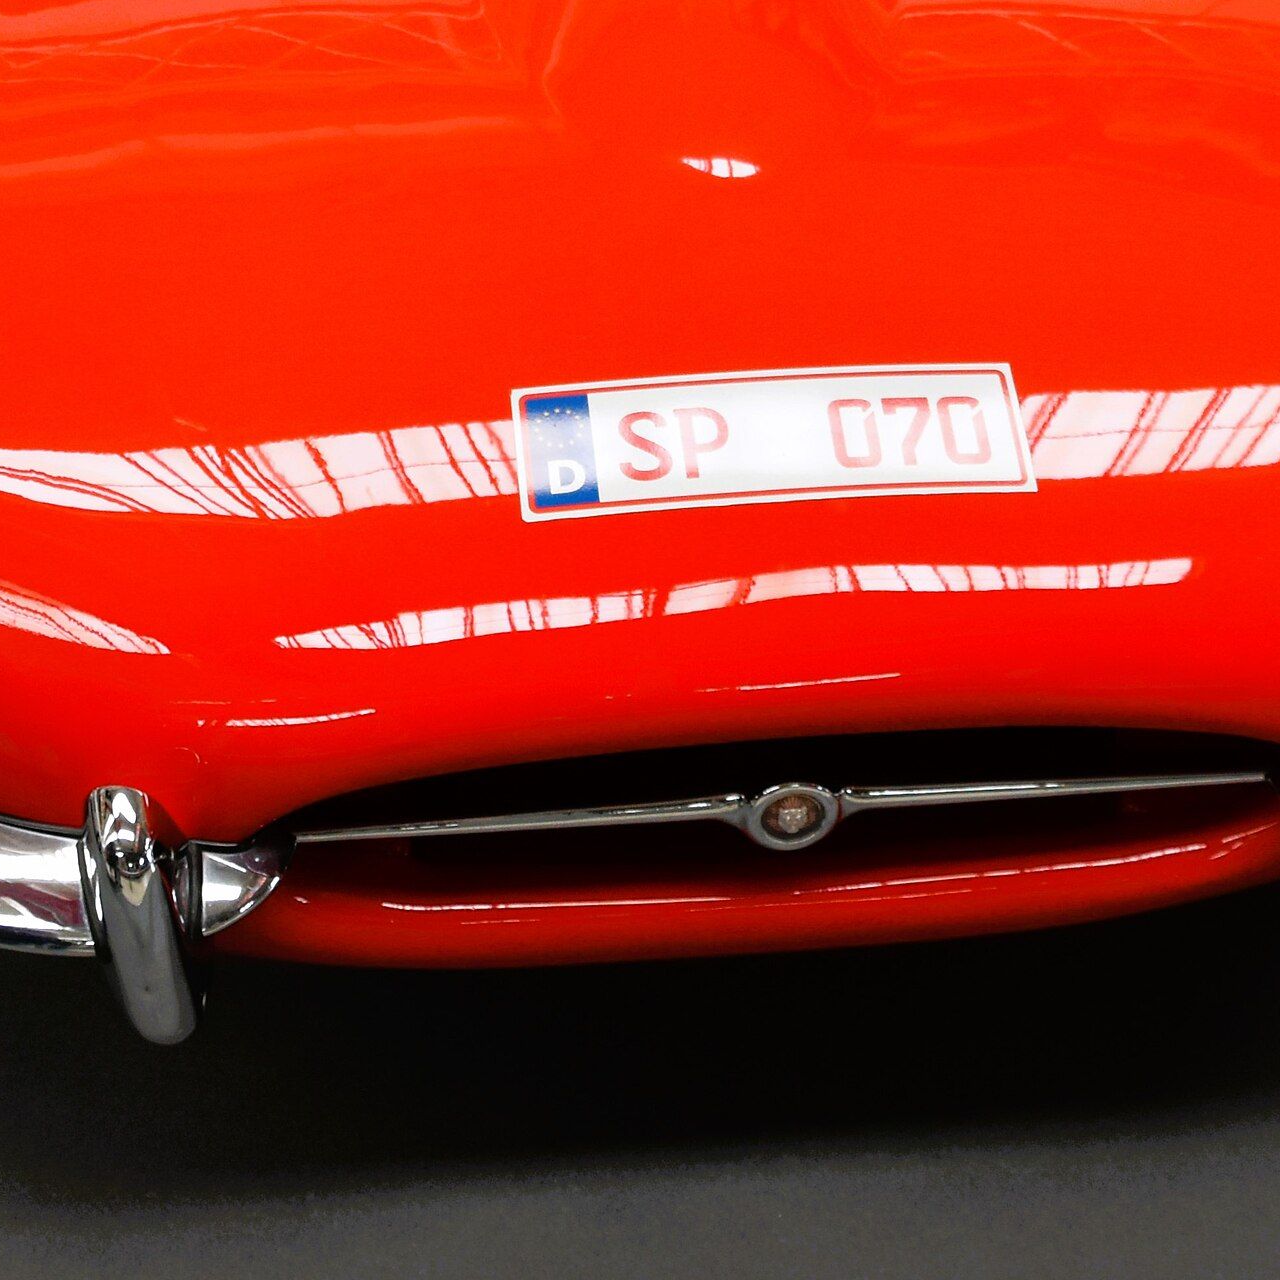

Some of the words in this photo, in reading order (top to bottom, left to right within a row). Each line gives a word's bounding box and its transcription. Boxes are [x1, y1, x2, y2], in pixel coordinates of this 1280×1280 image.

[619, 407, 730, 482] SP
[827, 395, 992, 468] 070
[547, 459, 586, 495] D
